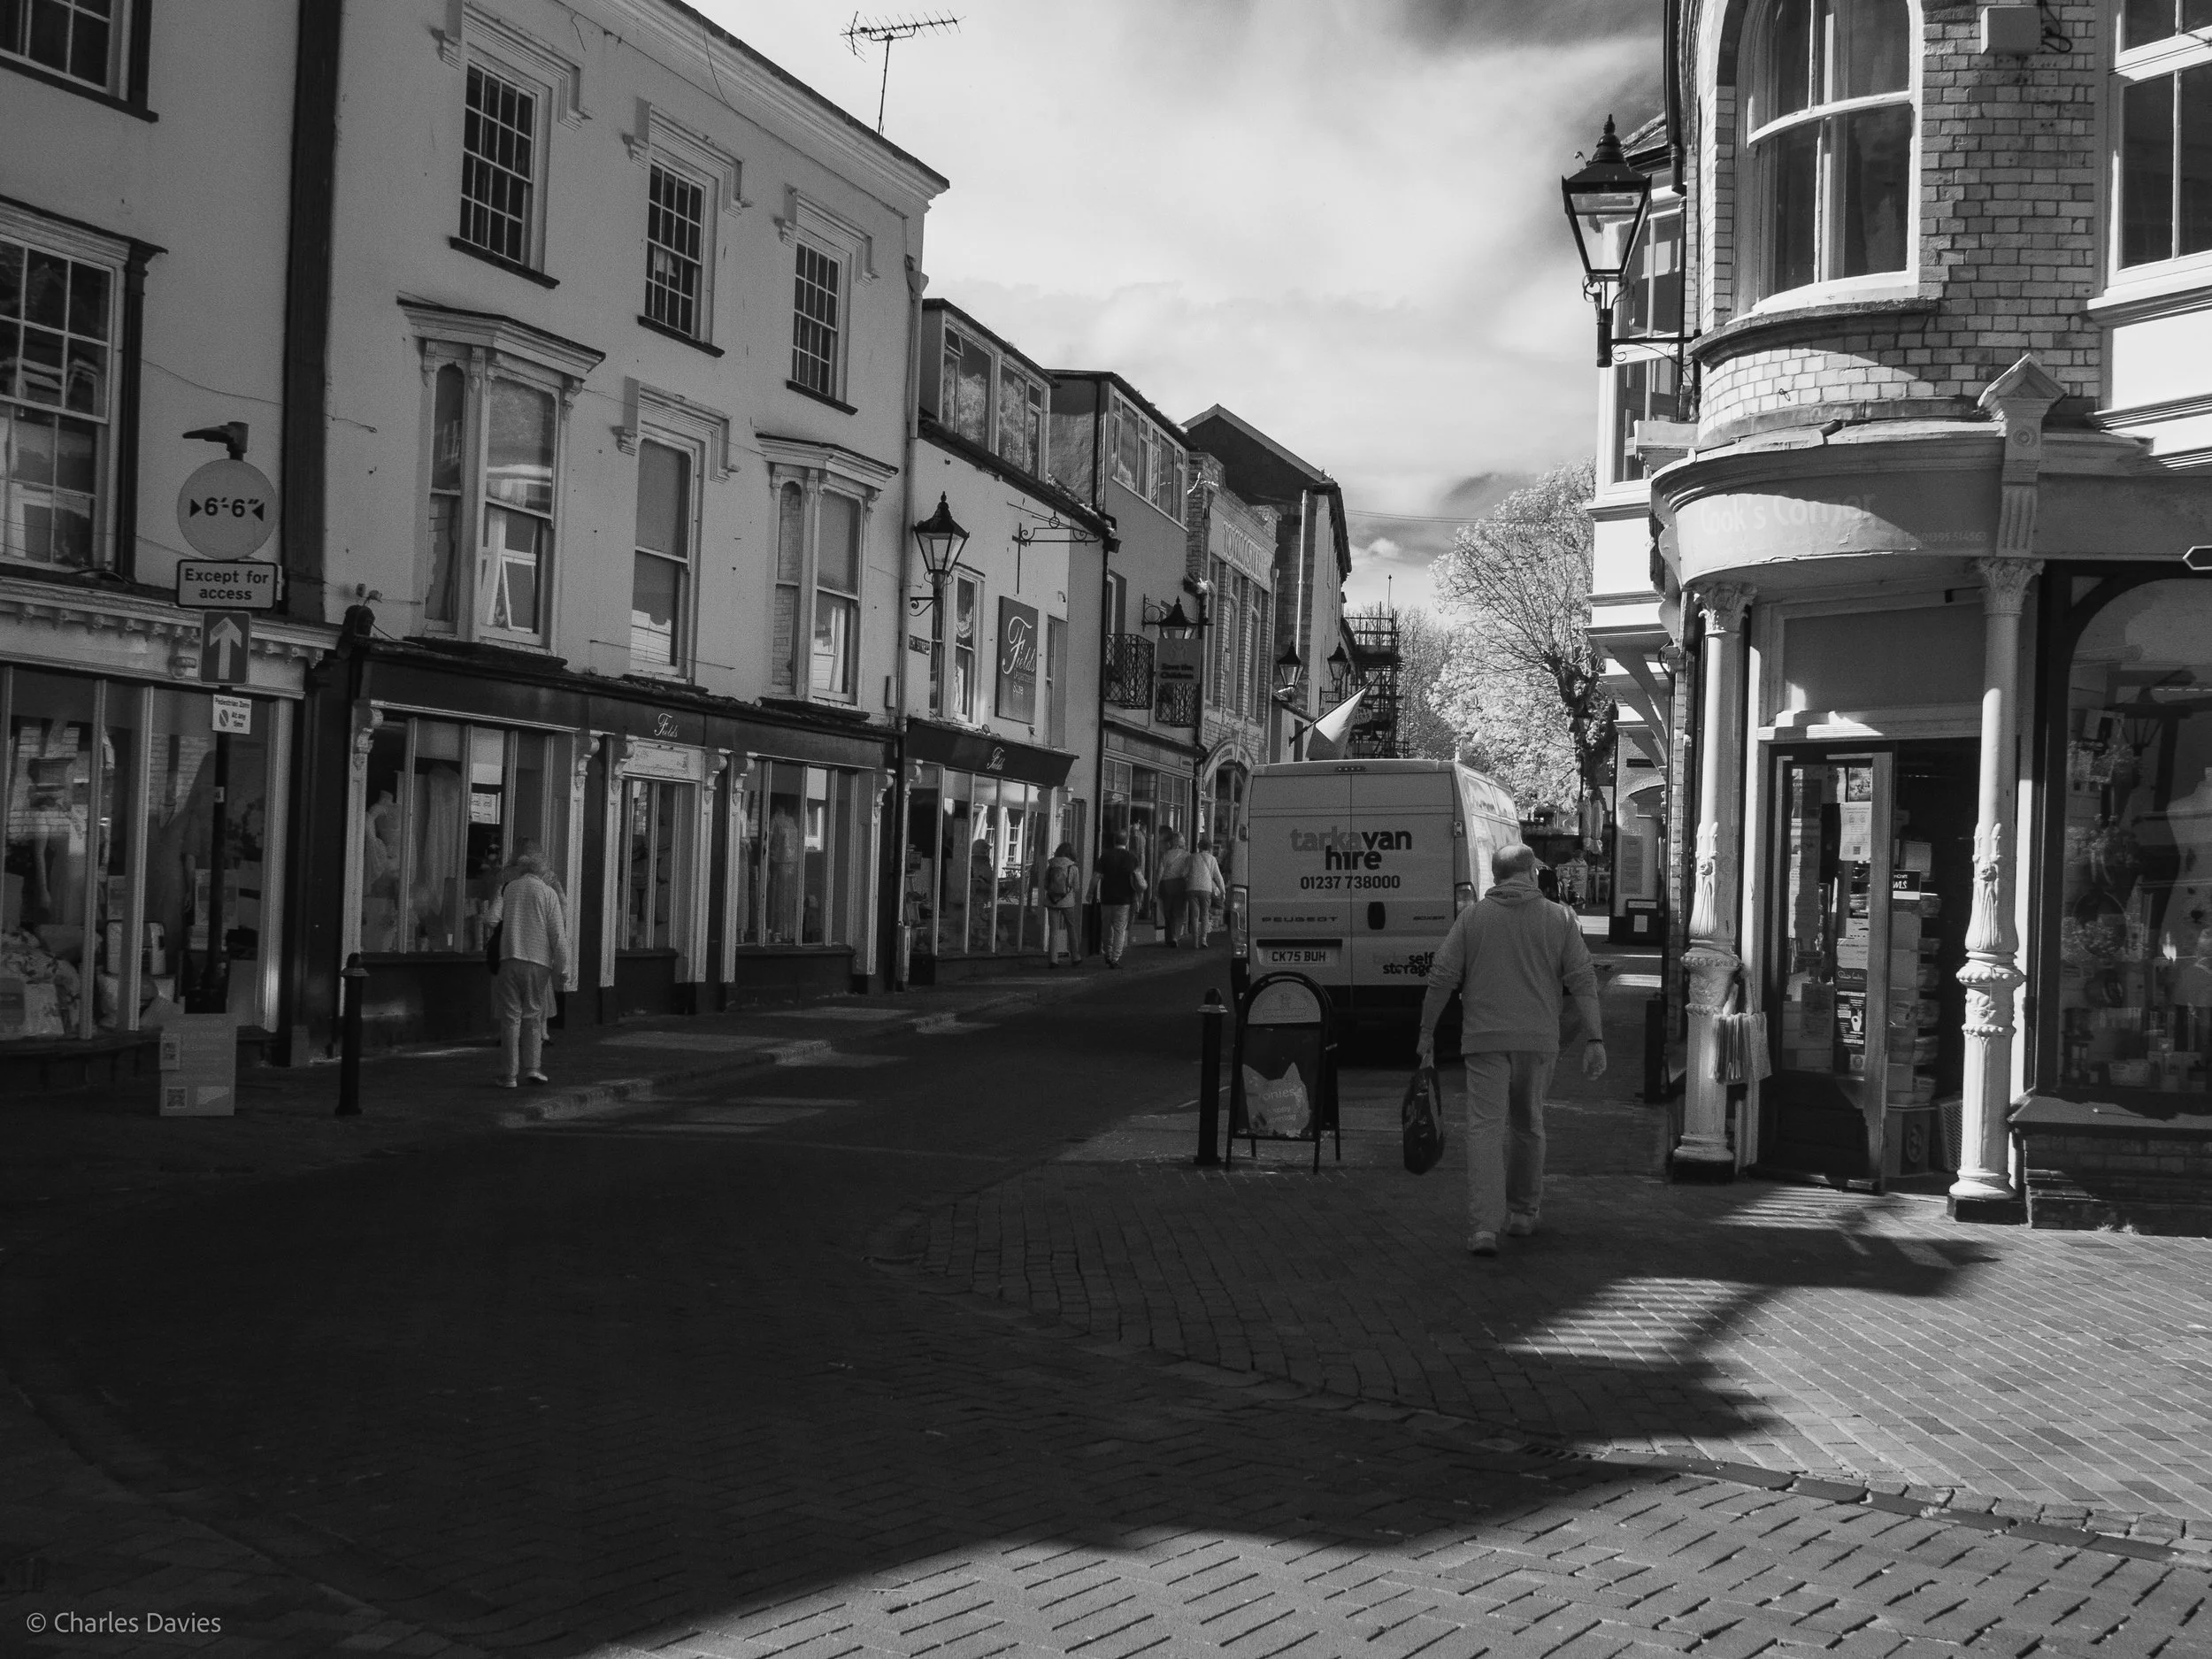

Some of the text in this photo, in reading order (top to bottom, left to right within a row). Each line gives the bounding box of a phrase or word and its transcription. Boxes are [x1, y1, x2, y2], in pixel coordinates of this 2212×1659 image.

[185, 568, 269, 584] Except for
[199, 588, 252, 600] access
[1002, 616, 1036, 675] Fields
[654, 712, 679, 738] Fields
[987, 747, 1006, 771] Fields
[1325, 845, 1382, 871] hire
[1300, 875, 1401, 890] 01237 738000
[1271, 951, 1326, 963] CK75 BUH
[1409, 952, 1435, 965] self
